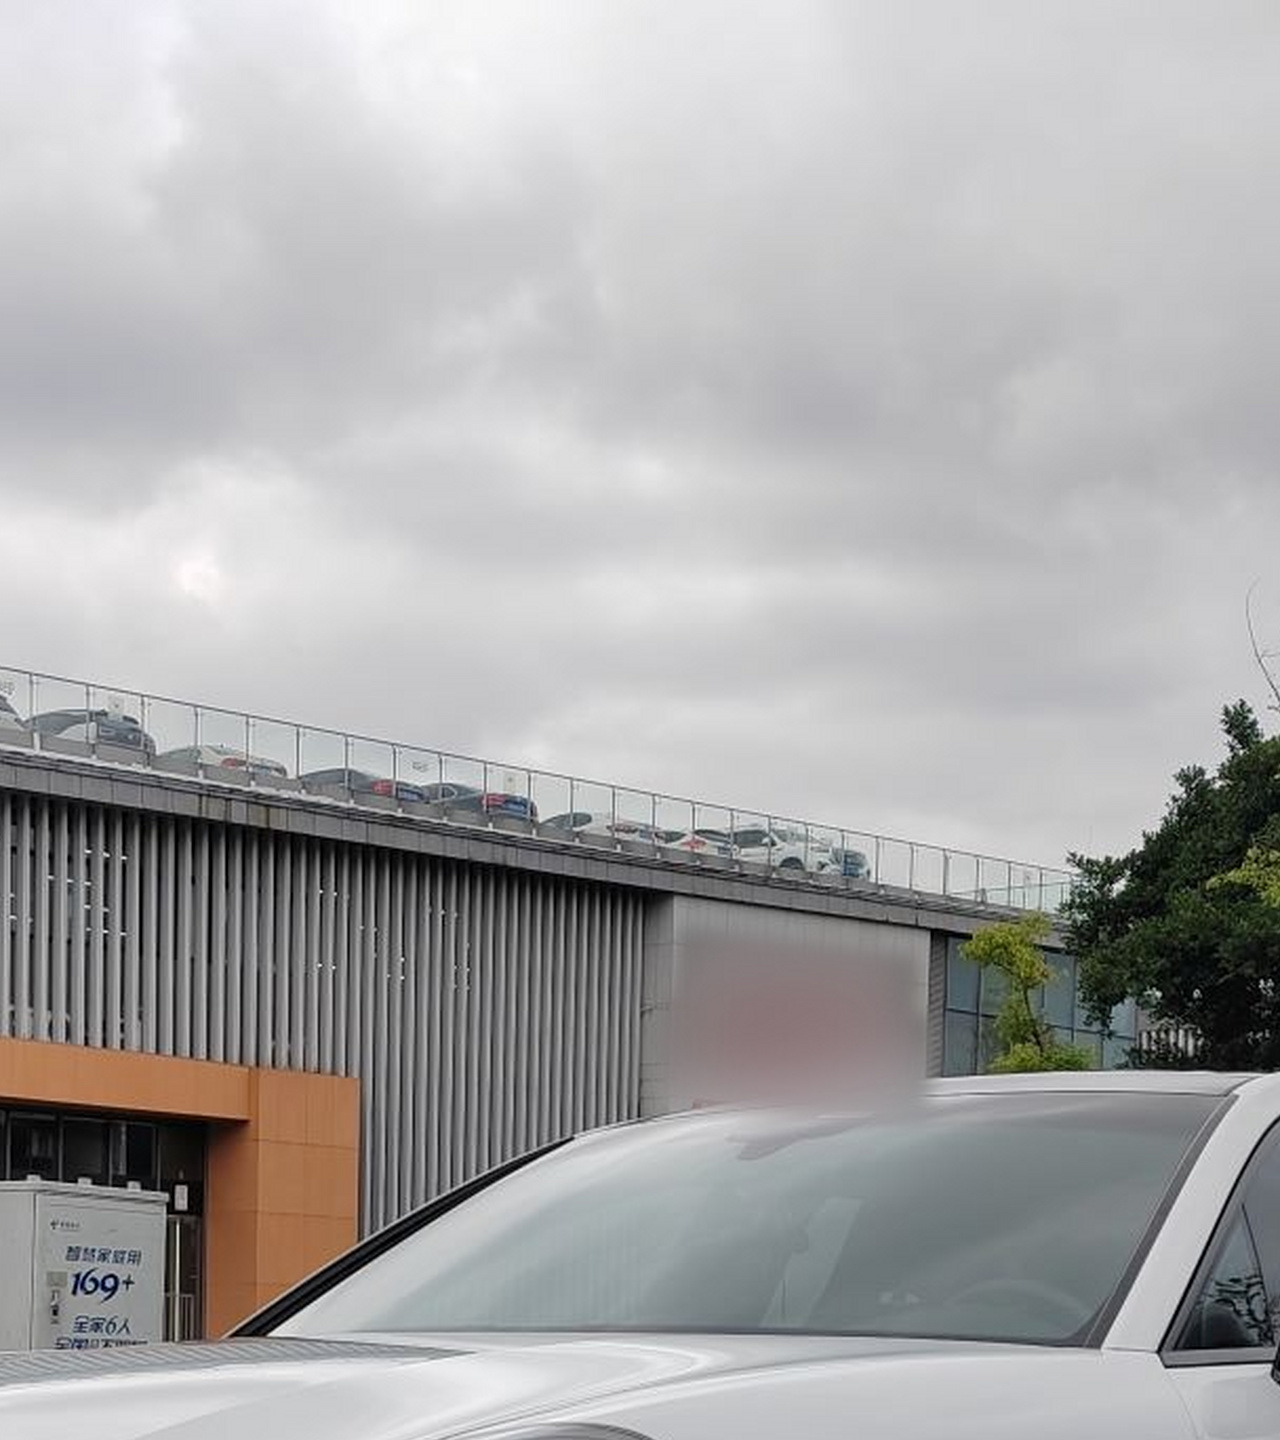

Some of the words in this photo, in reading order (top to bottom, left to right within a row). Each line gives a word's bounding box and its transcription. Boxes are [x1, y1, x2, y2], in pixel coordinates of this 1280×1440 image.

[71, 1268, 135, 1304] 169+
[72, 1315, 131, 1335] 全家6人
